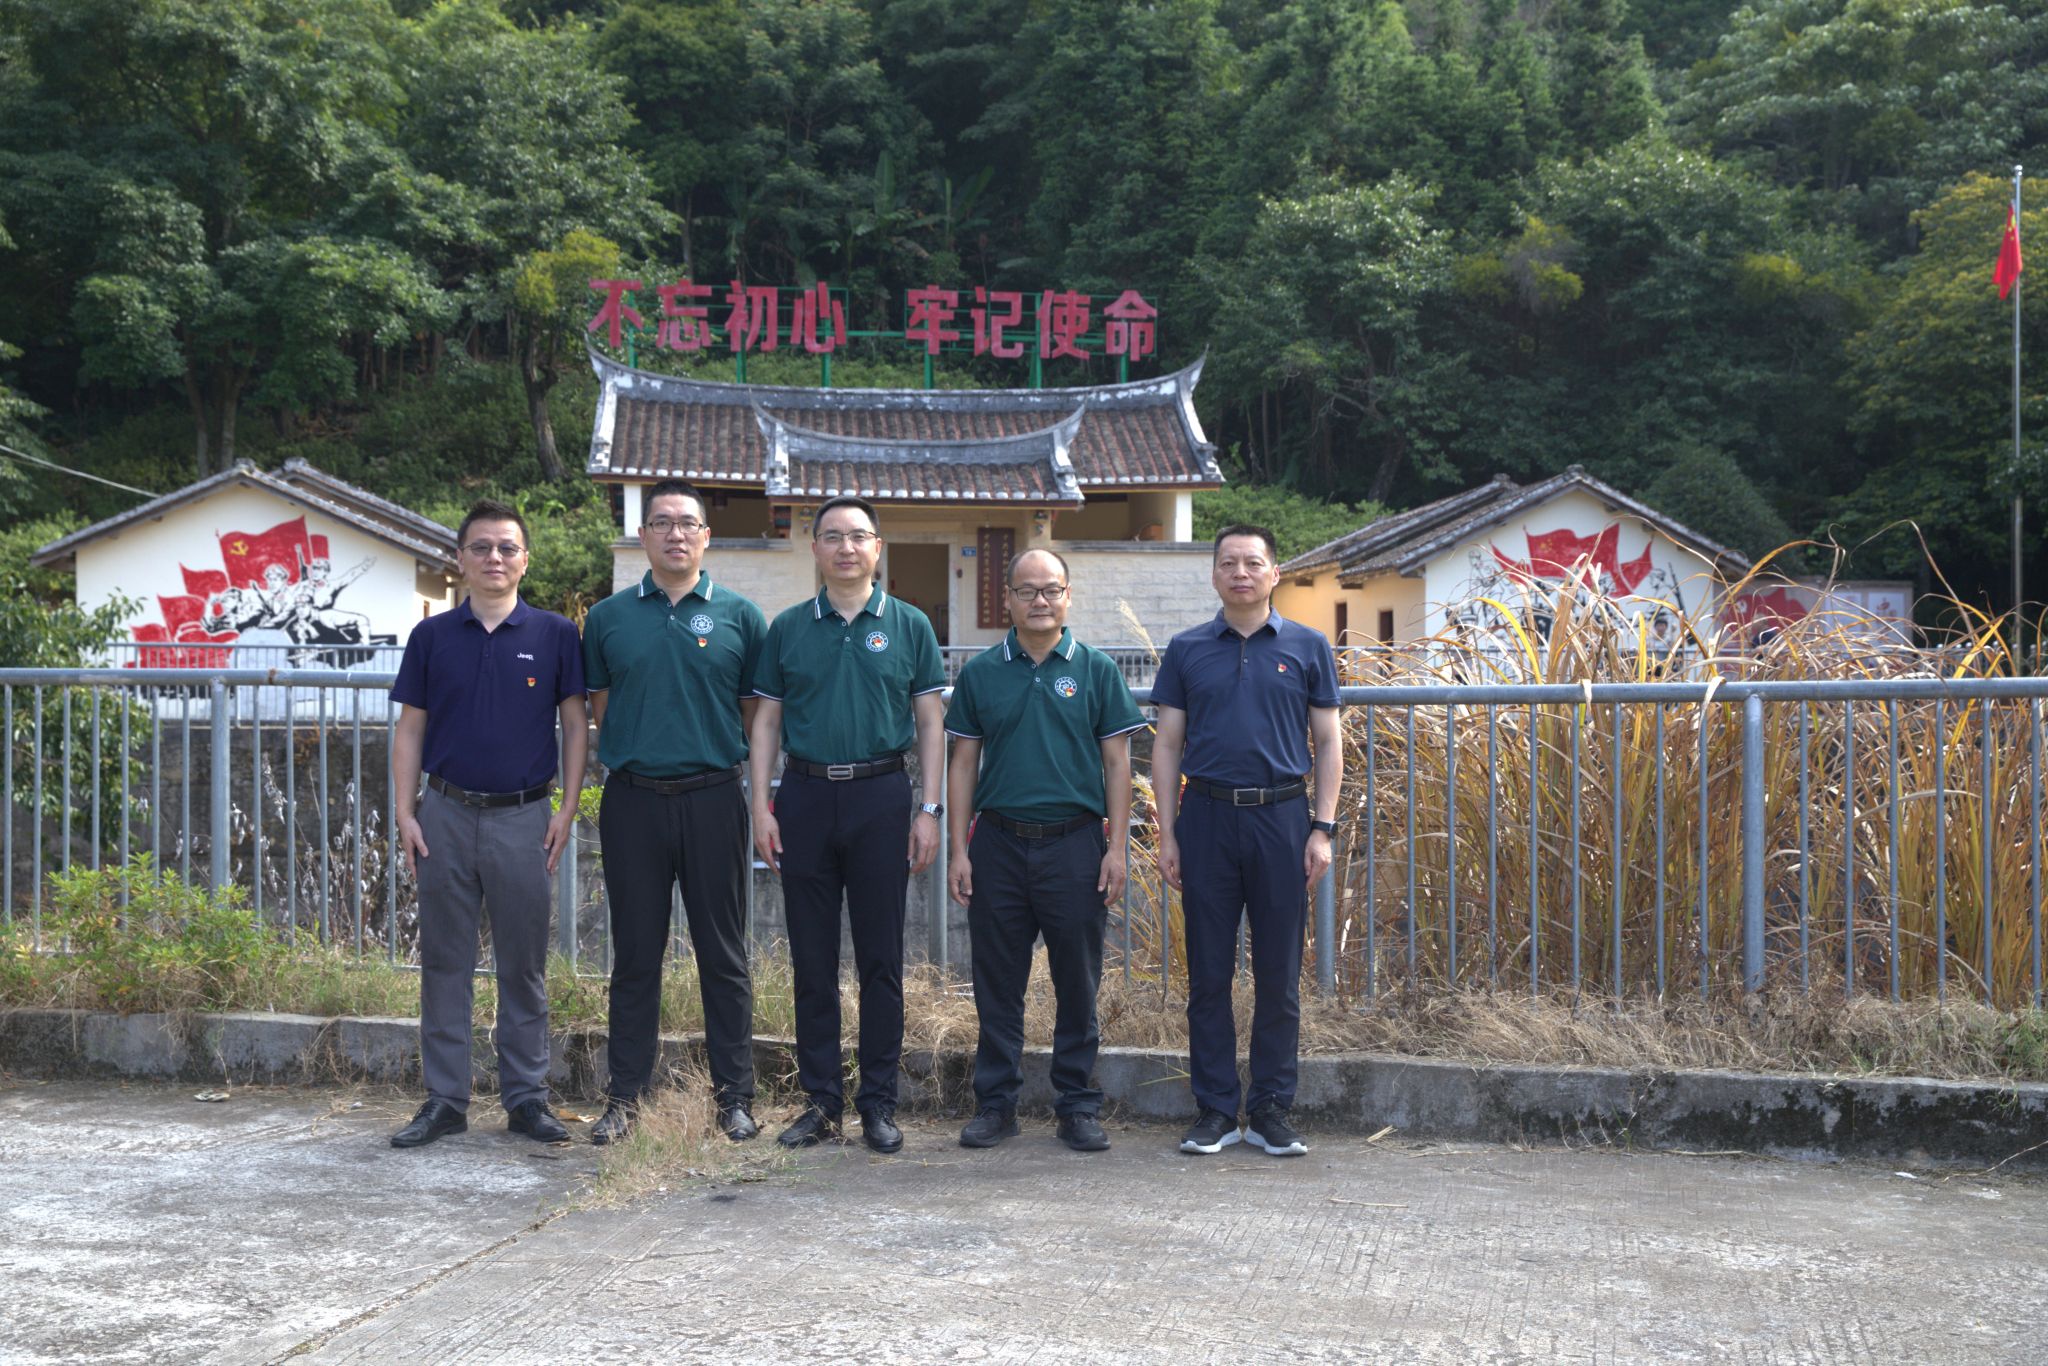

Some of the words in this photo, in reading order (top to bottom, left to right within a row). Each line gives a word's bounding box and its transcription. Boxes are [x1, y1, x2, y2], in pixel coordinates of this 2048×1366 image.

[588, 279, 847, 353] 不忘初心
[906, 285, 1158, 361] 牢记使命
